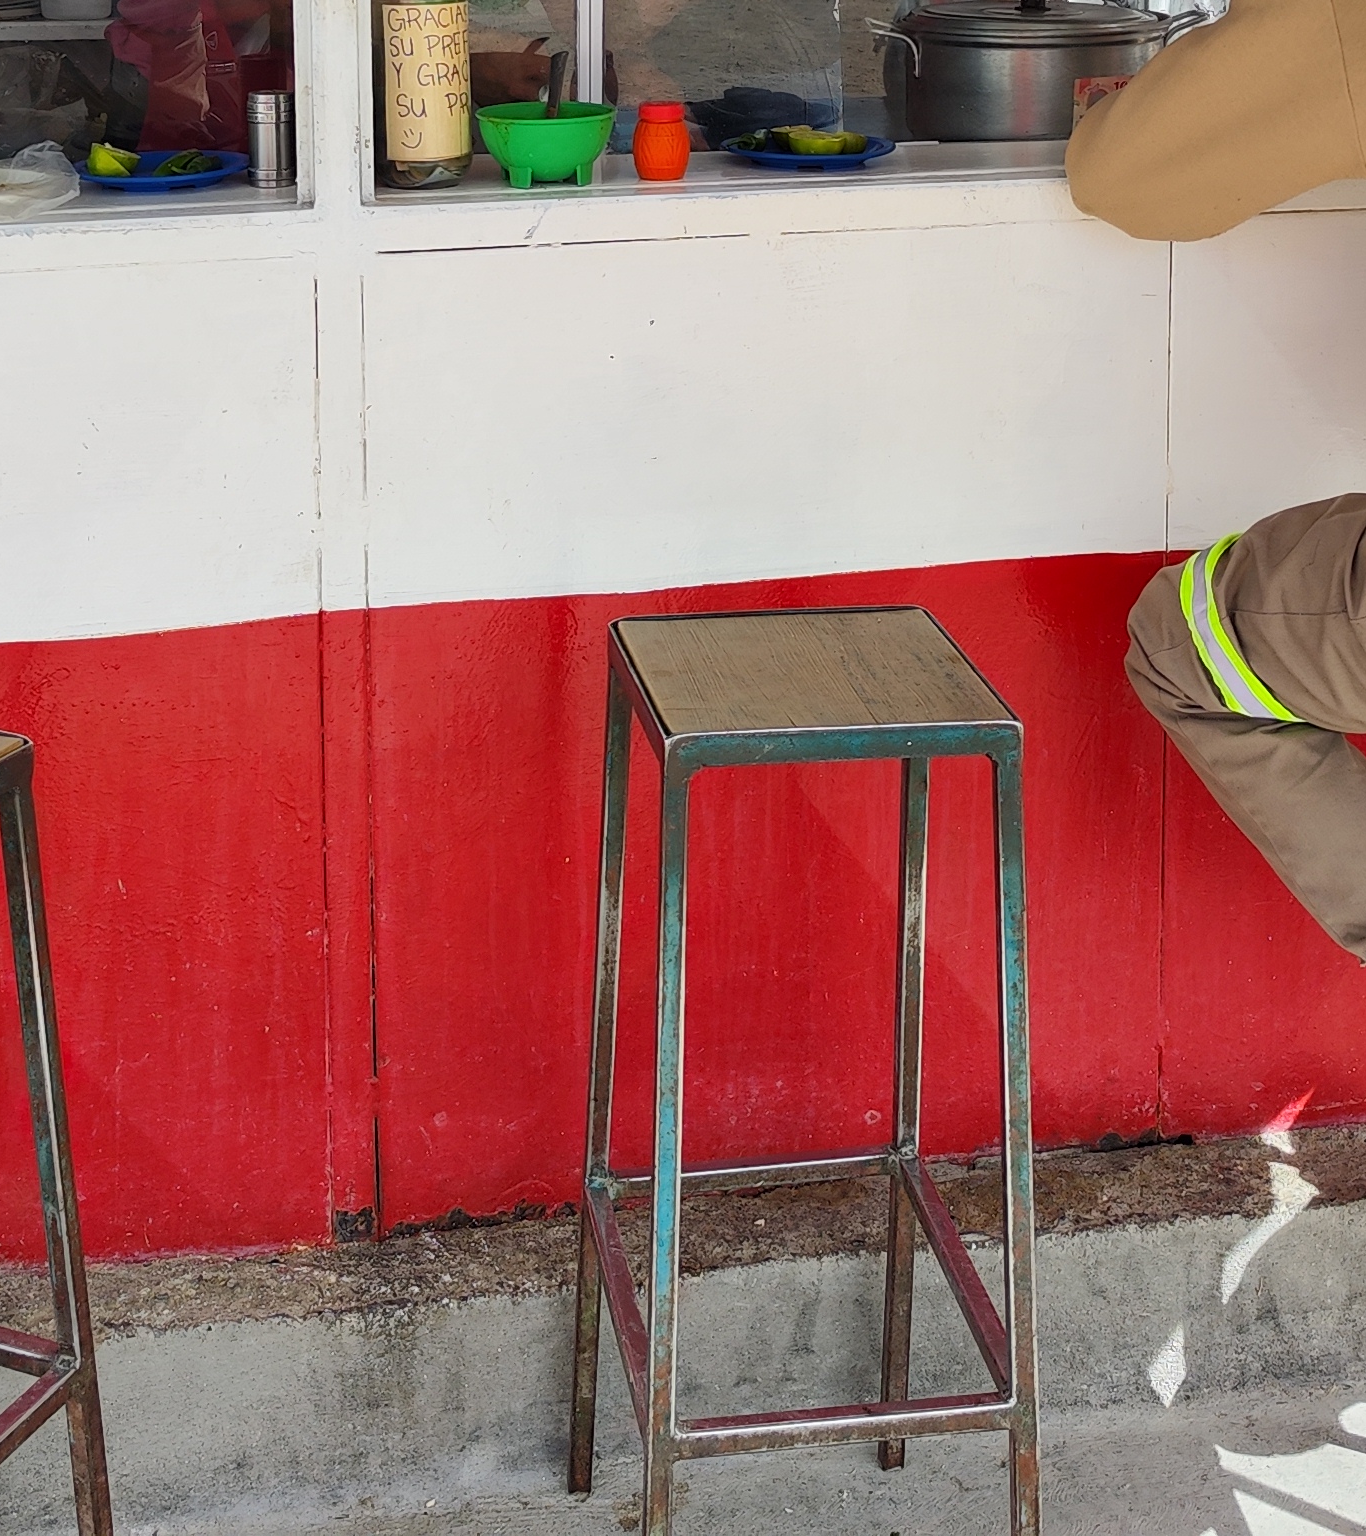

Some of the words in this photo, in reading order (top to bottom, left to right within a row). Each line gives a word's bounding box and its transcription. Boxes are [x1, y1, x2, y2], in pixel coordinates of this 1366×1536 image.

[389, 35, 414, 58] SU
[391, 61, 403, 89] Y
[396, 92, 427, 118] SU
